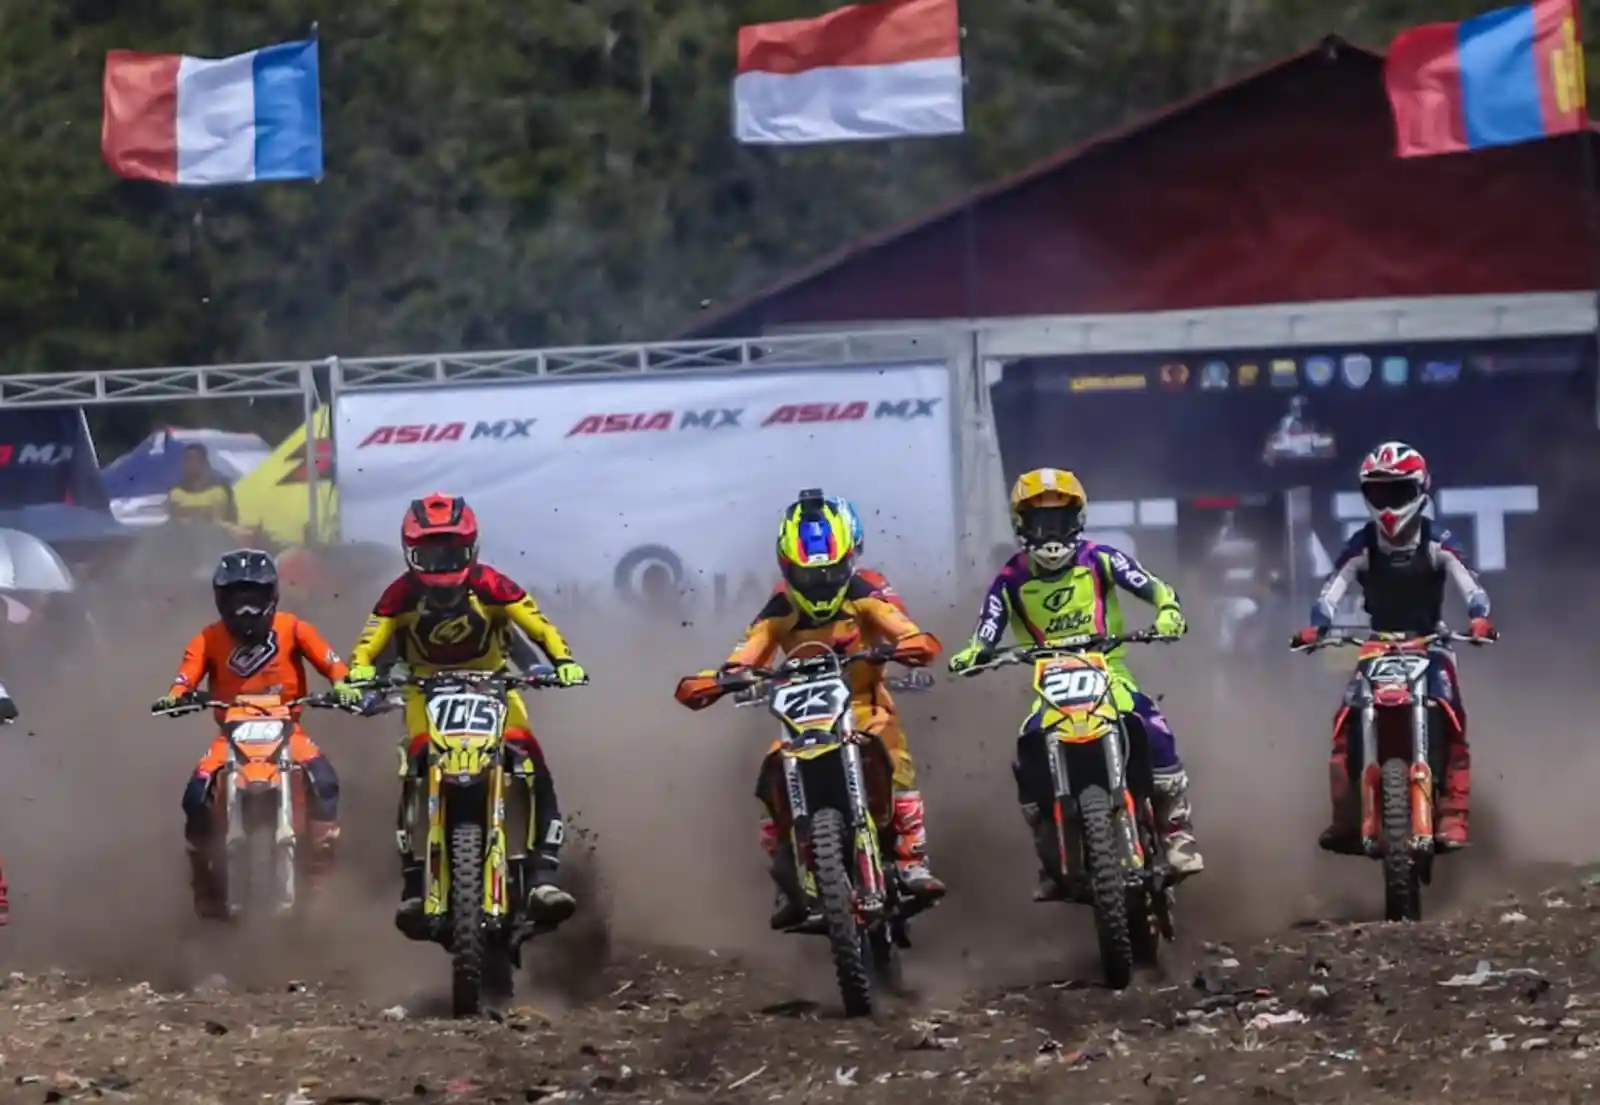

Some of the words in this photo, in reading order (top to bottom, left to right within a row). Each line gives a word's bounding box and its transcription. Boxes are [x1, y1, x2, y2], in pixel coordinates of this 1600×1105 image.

[563, 410, 675, 438] ASIA
[679, 407, 745, 430] MX
[760, 401, 869, 428] ASIA
[874, 397, 943, 421] MX
[356, 421, 468, 449] ASIA
[470, 417, 538, 440] MX
[435, 698, 497, 732] 105
